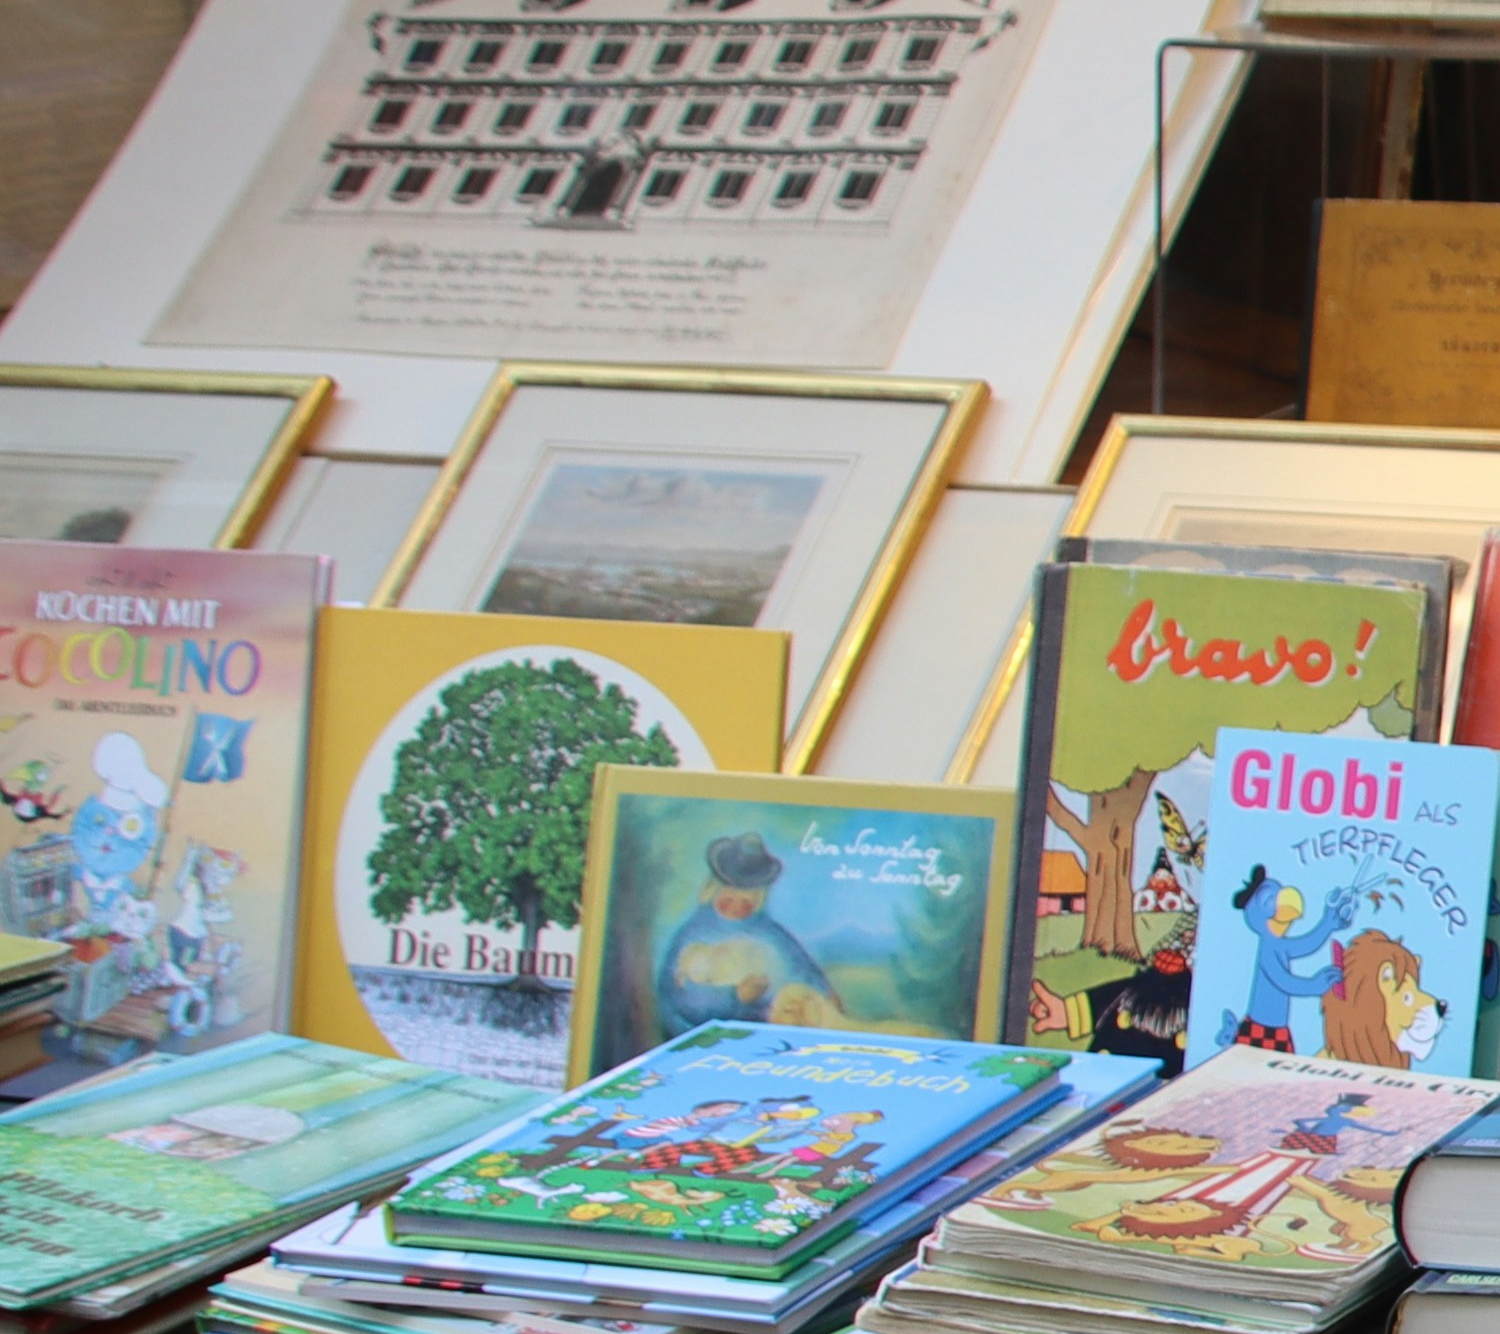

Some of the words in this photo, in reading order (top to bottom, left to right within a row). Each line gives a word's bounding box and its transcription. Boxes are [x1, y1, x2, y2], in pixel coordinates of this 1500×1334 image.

[35, 590, 158, 626] KOCHEN
[161, 598, 221, 629] MIT
[1106, 599, 1379, 688] bravo!
[1229, 748, 1404, 821] Globi
[1414, 799, 1462, 827] ALS
[800, 821, 840, 856] Von
[845, 828, 941, 866] Sonntag
[832, 864, 863, 880] zu
[871, 861, 962, 896] Sonntag
[1290, 824, 1469, 936] TIERPFLEGER
[389, 927, 450, 969] Die
[464, 933, 575, 978] Baum
[676, 1054, 971, 1094] Freundebuch
[1266, 1060, 1365, 1081] Globi
